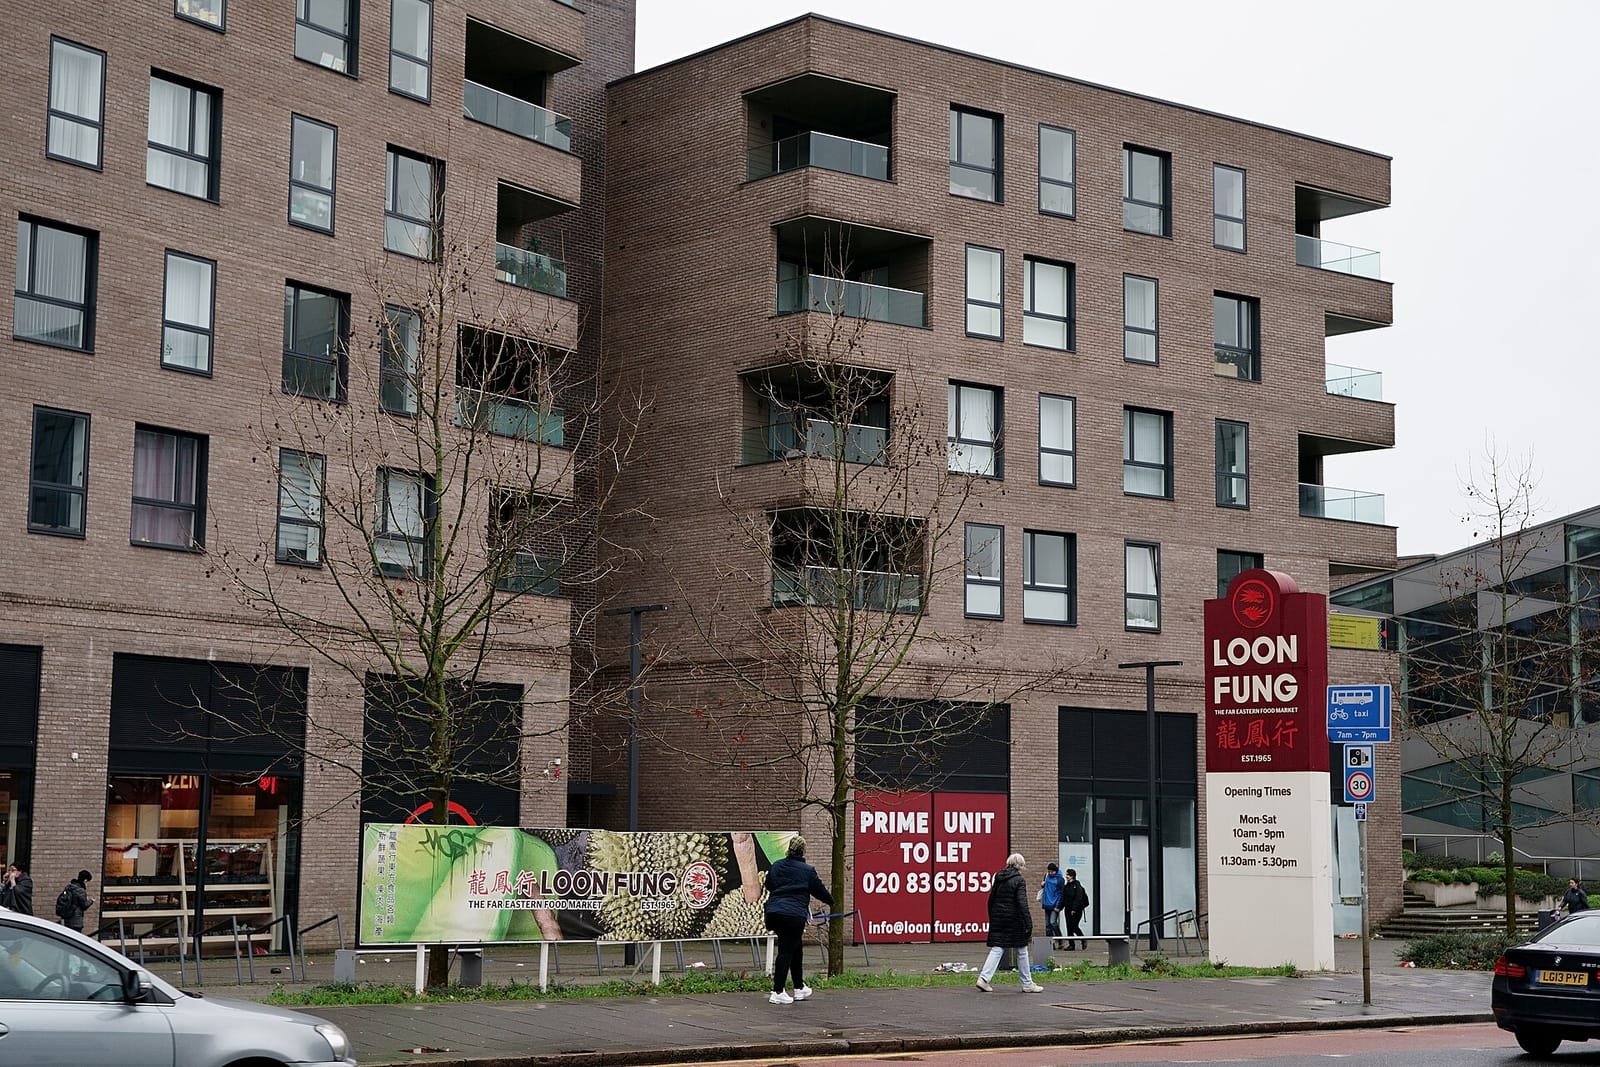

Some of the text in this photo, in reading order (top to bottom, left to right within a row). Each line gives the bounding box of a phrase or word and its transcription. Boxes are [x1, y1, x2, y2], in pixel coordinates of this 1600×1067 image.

[1213, 634, 1298, 667] LOON
[1214, 673, 1298, 705] FUNG
[1354, 709, 1369, 718] taxi
[1215, 719, 1298, 749] 龍鳳行
[1337, 731, 1352, 739] 7am
[1362, 731, 1377, 740] 7pm
[1241, 754, 1272, 762] EST.1965
[1352, 780, 1367, 790] 30
[1224, 787, 1291, 798] Opening Times
[860, 811, 995, 833] PRIME UNIT
[1239, 815, 1277, 824] Mon-Sat
[1233, 829, 1257, 838] 10am
[1264, 830, 1285, 840] 9pm
[900, 842, 971, 863] TO LET
[1242, 843, 1276, 854] Sunday
[1220, 856, 1256, 867] 11.30am
[1263, 857, 1297, 868] 5.30pm
[468, 870, 537, 896] 龍鳳行
[541, 870, 676, 896] LOON FUNG
[863, 872, 900, 894] 020
[468, 900, 601, 909] THE FAR EASTERN FOOD MARKET
[868, 920, 990, 936] info@loonfung.co.u
[1543, 972, 1584, 983] LG13 PYF
